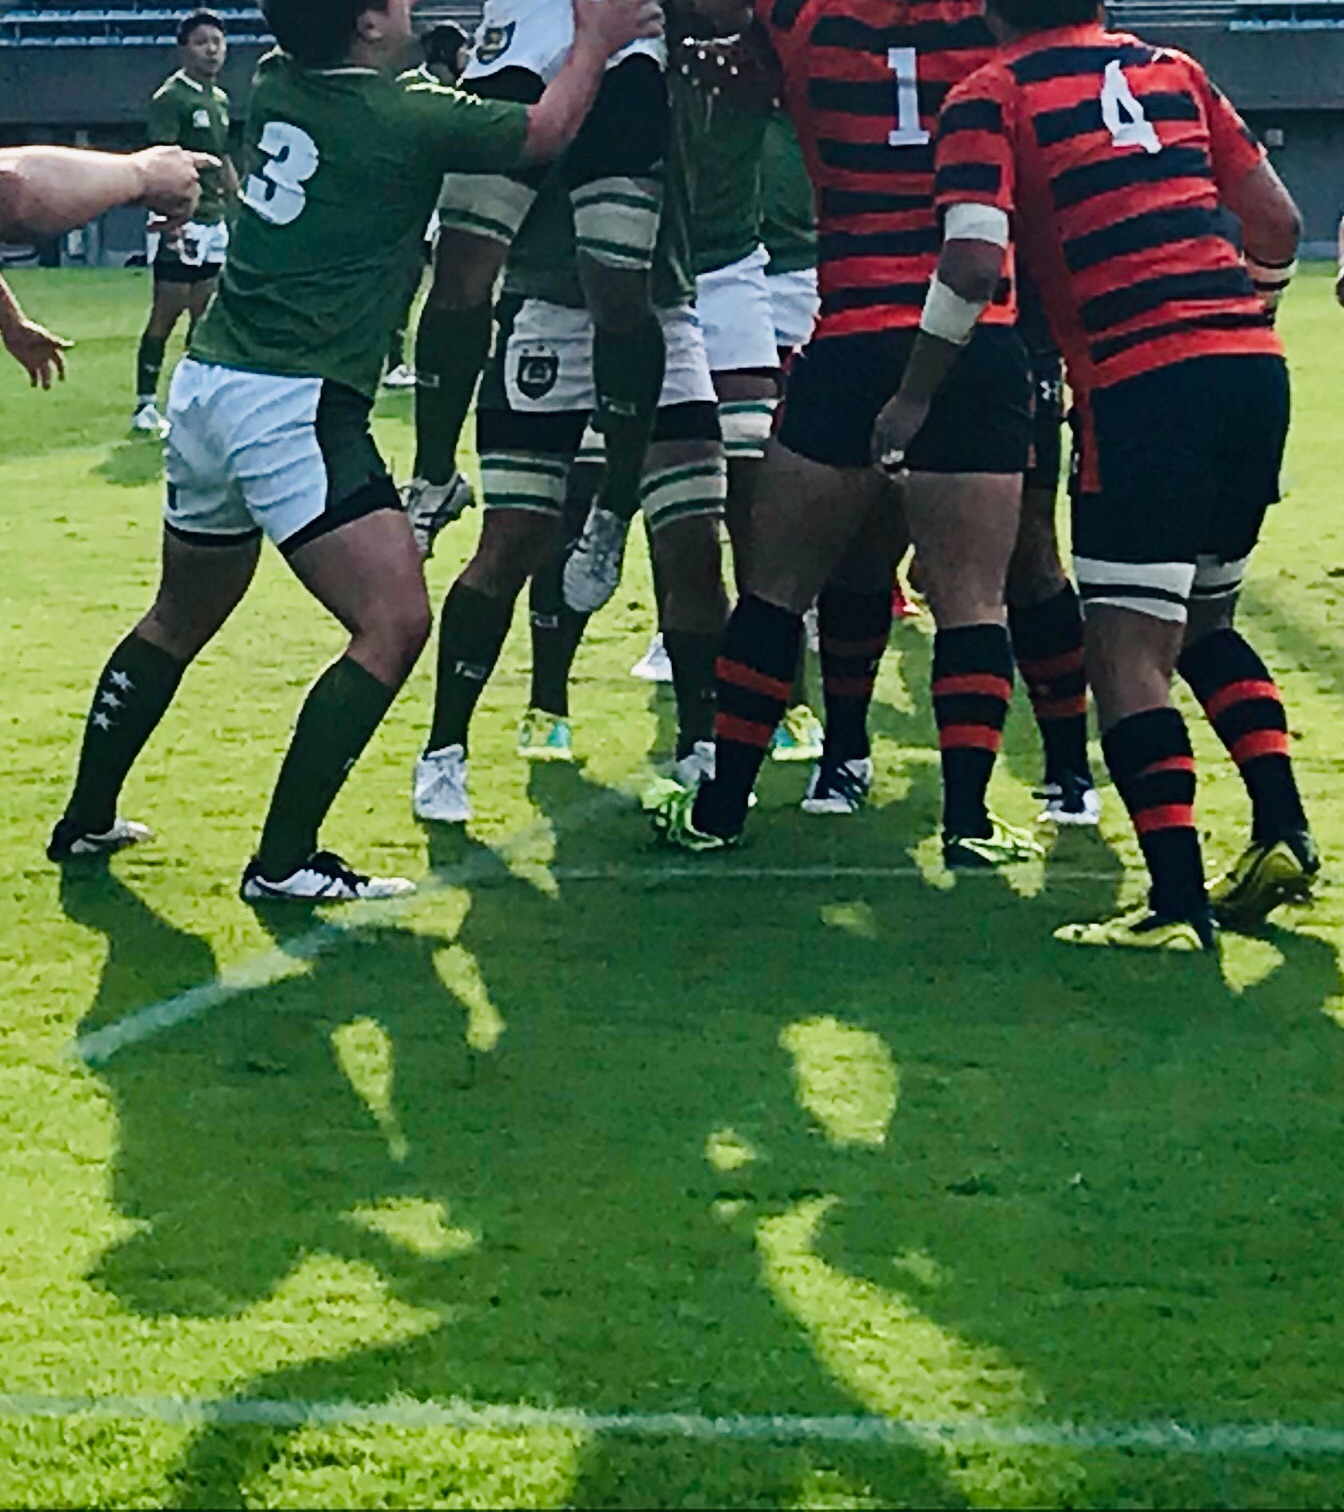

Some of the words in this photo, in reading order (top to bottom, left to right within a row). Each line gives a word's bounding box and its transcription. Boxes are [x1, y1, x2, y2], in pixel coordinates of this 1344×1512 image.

[888, 47, 930, 146] 1
[1101, 59, 1162, 153] 4
[240, 121, 319, 225] 3
